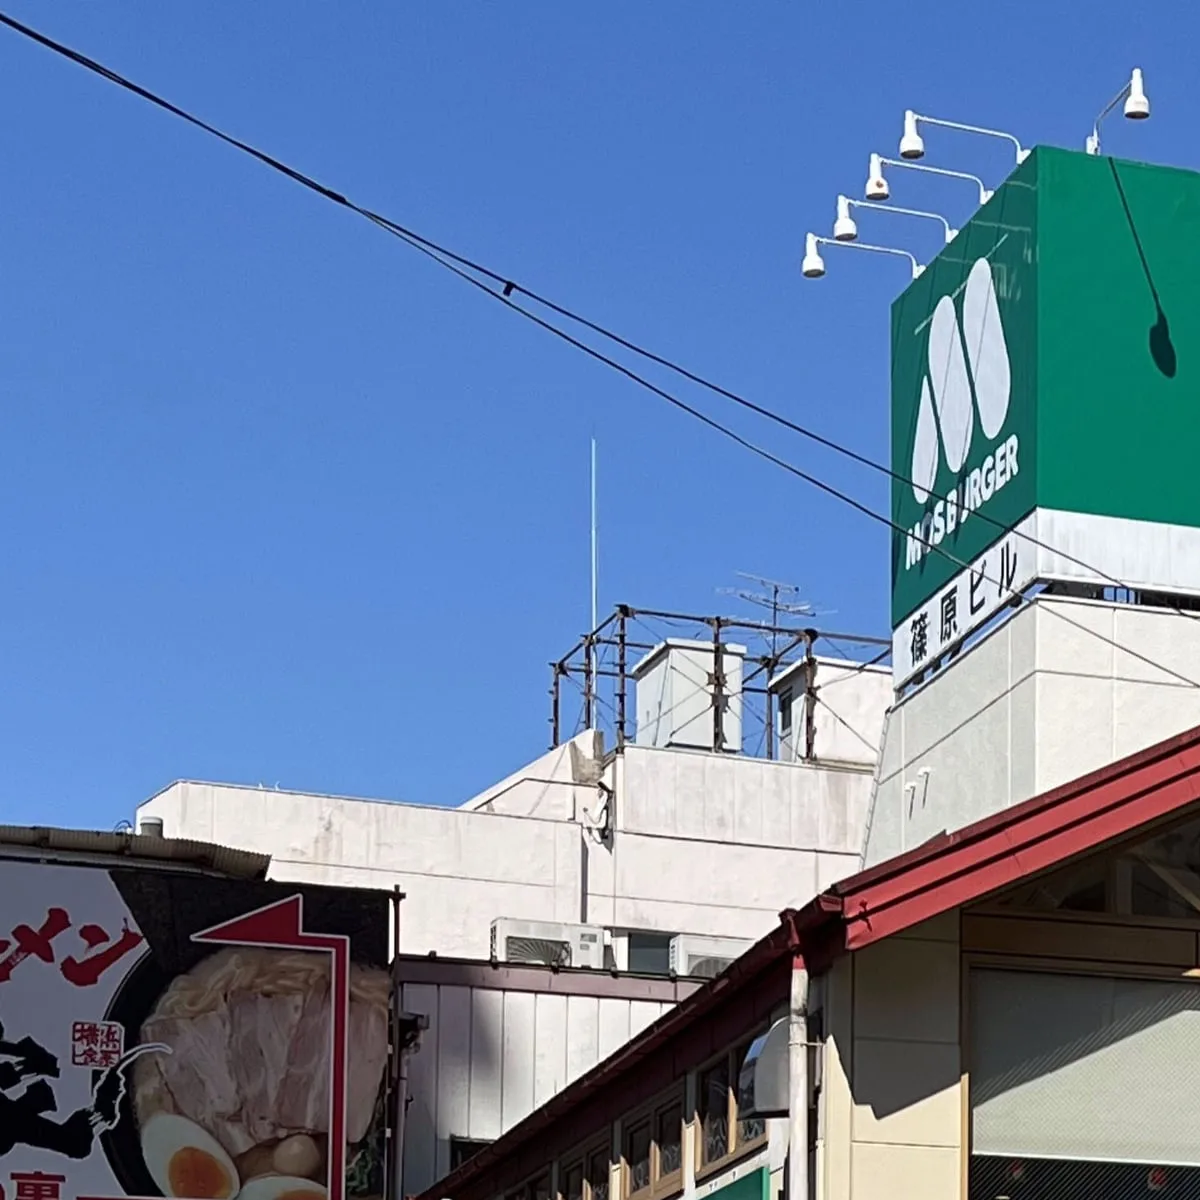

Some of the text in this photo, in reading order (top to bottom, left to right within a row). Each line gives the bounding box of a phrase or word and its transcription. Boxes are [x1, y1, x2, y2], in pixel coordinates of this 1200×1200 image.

[906, 434, 1019, 571] MOS BURGER
[911, 541, 1017, 669] 篠原ビル
[0, 907, 144, 987] メン
